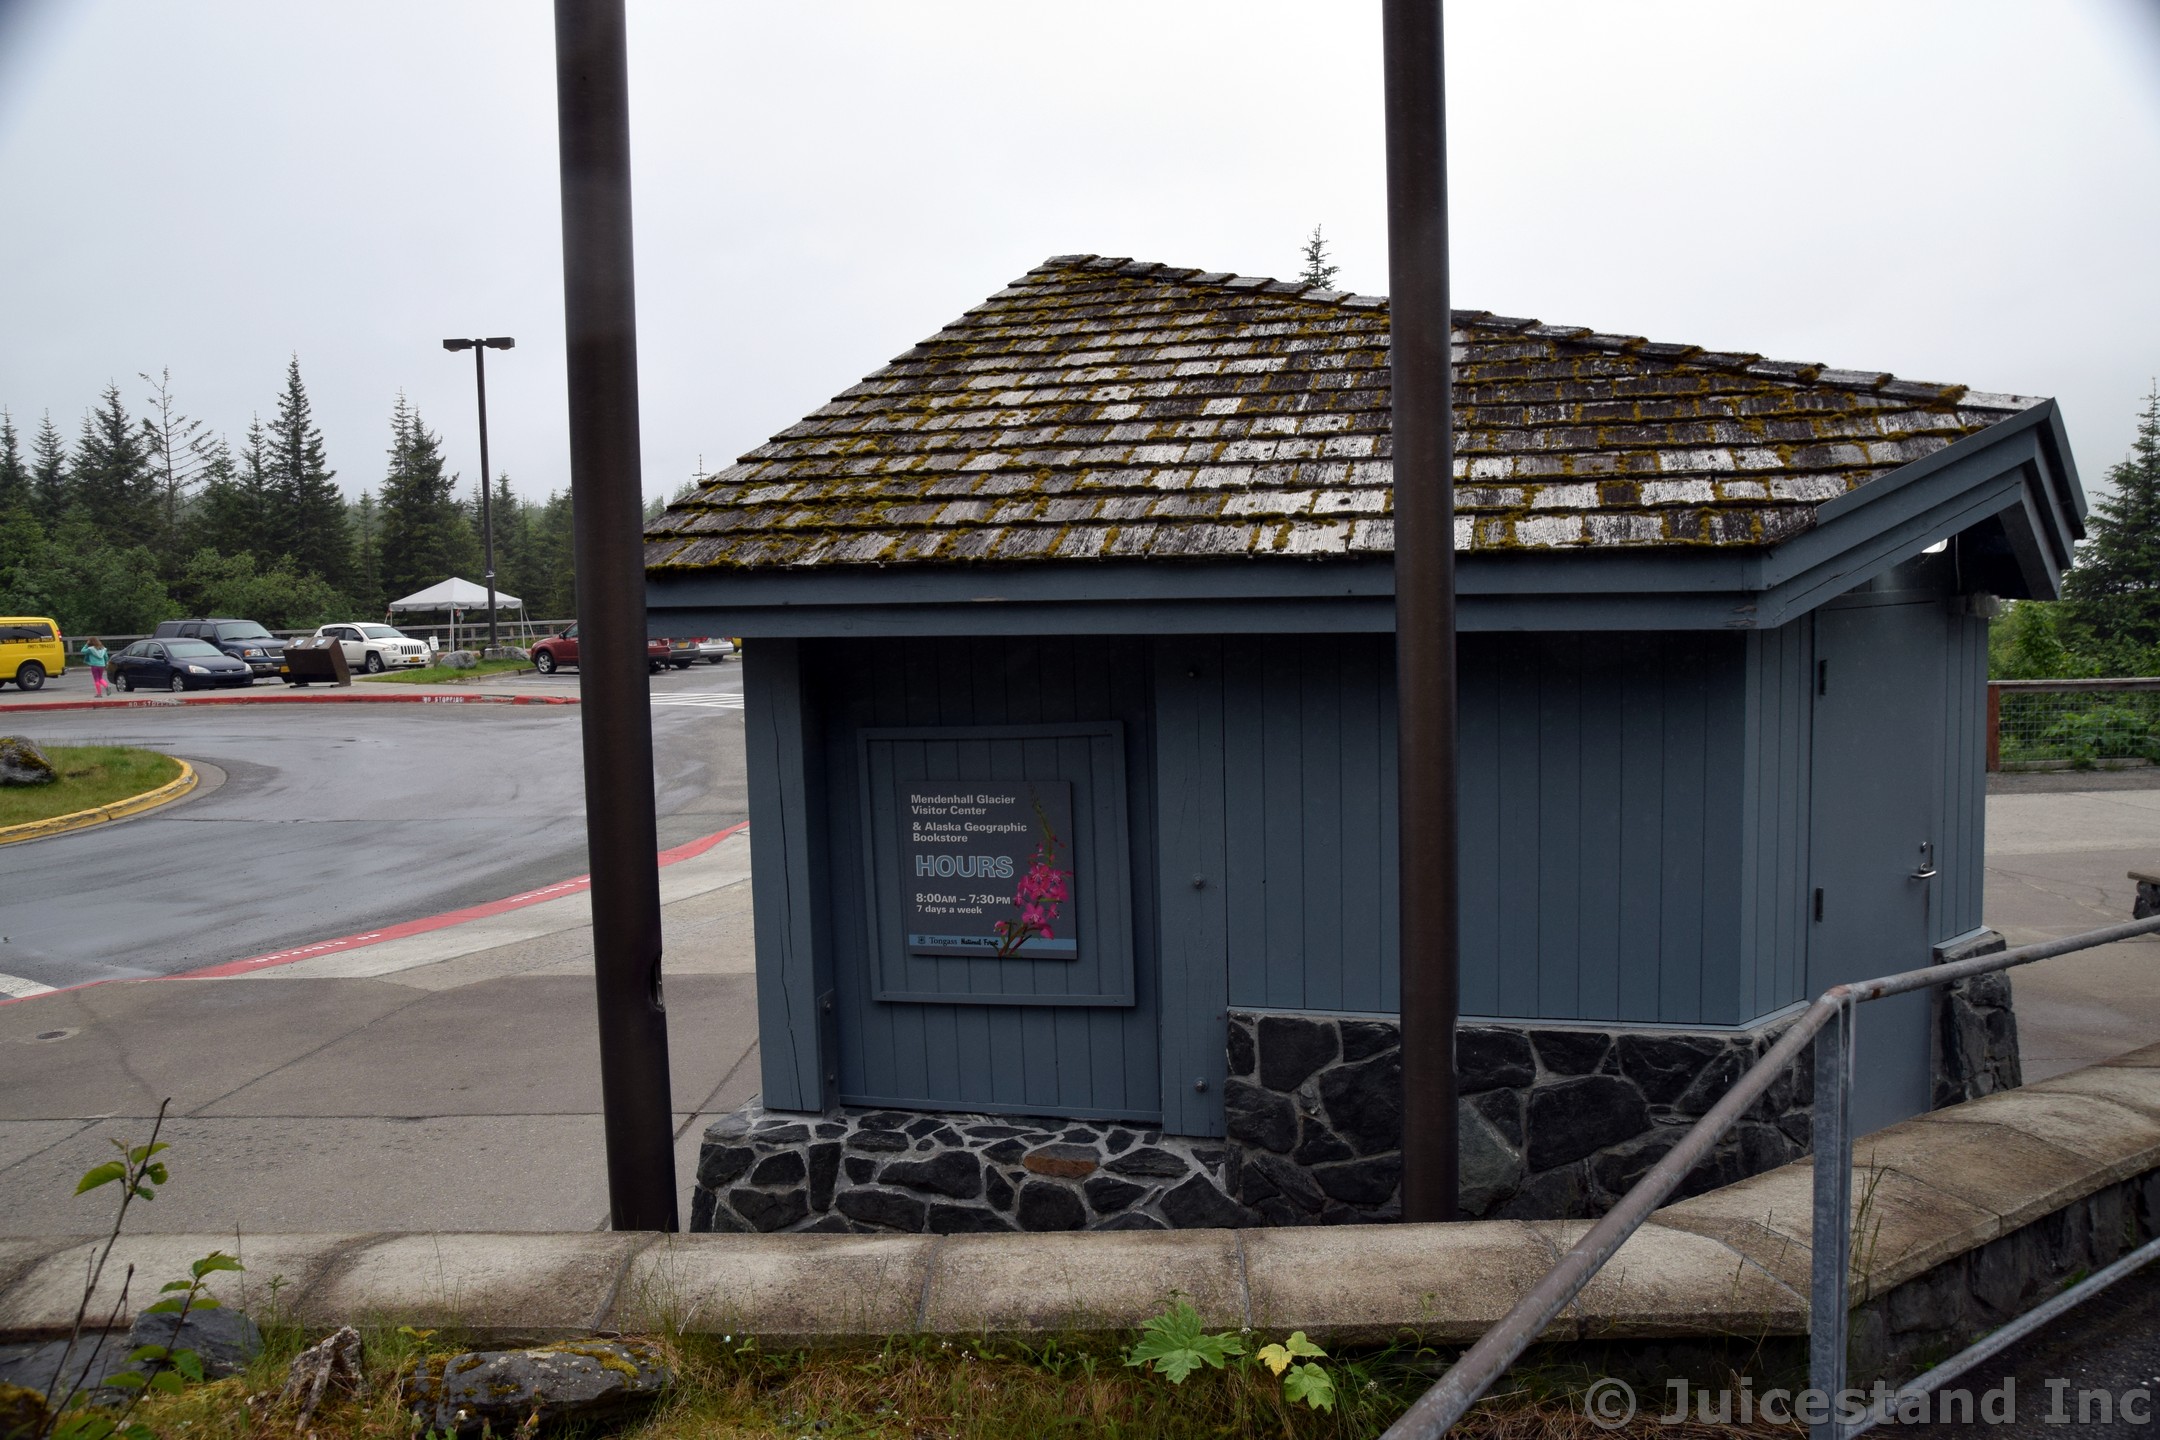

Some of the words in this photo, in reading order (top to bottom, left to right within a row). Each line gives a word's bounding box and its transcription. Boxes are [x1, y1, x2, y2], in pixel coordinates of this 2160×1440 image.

[911, 794, 974, 804] Mendenhall
[976, 794, 1015, 804] Glacier
[911, 805, 947, 815] Visitor
[949, 806, 987, 815] Center
[912, 822, 922, 831] &
[924, 822, 961, 831] Alaska
[964, 822, 1028, 834] Geographic
[912, 833, 968, 842] Bookstore
[915, 854, 1014, 879] HOURS
[924, 905, 947, 914] days
[956, 906, 983, 914] week
[928, 936, 958, 947] Tongass
